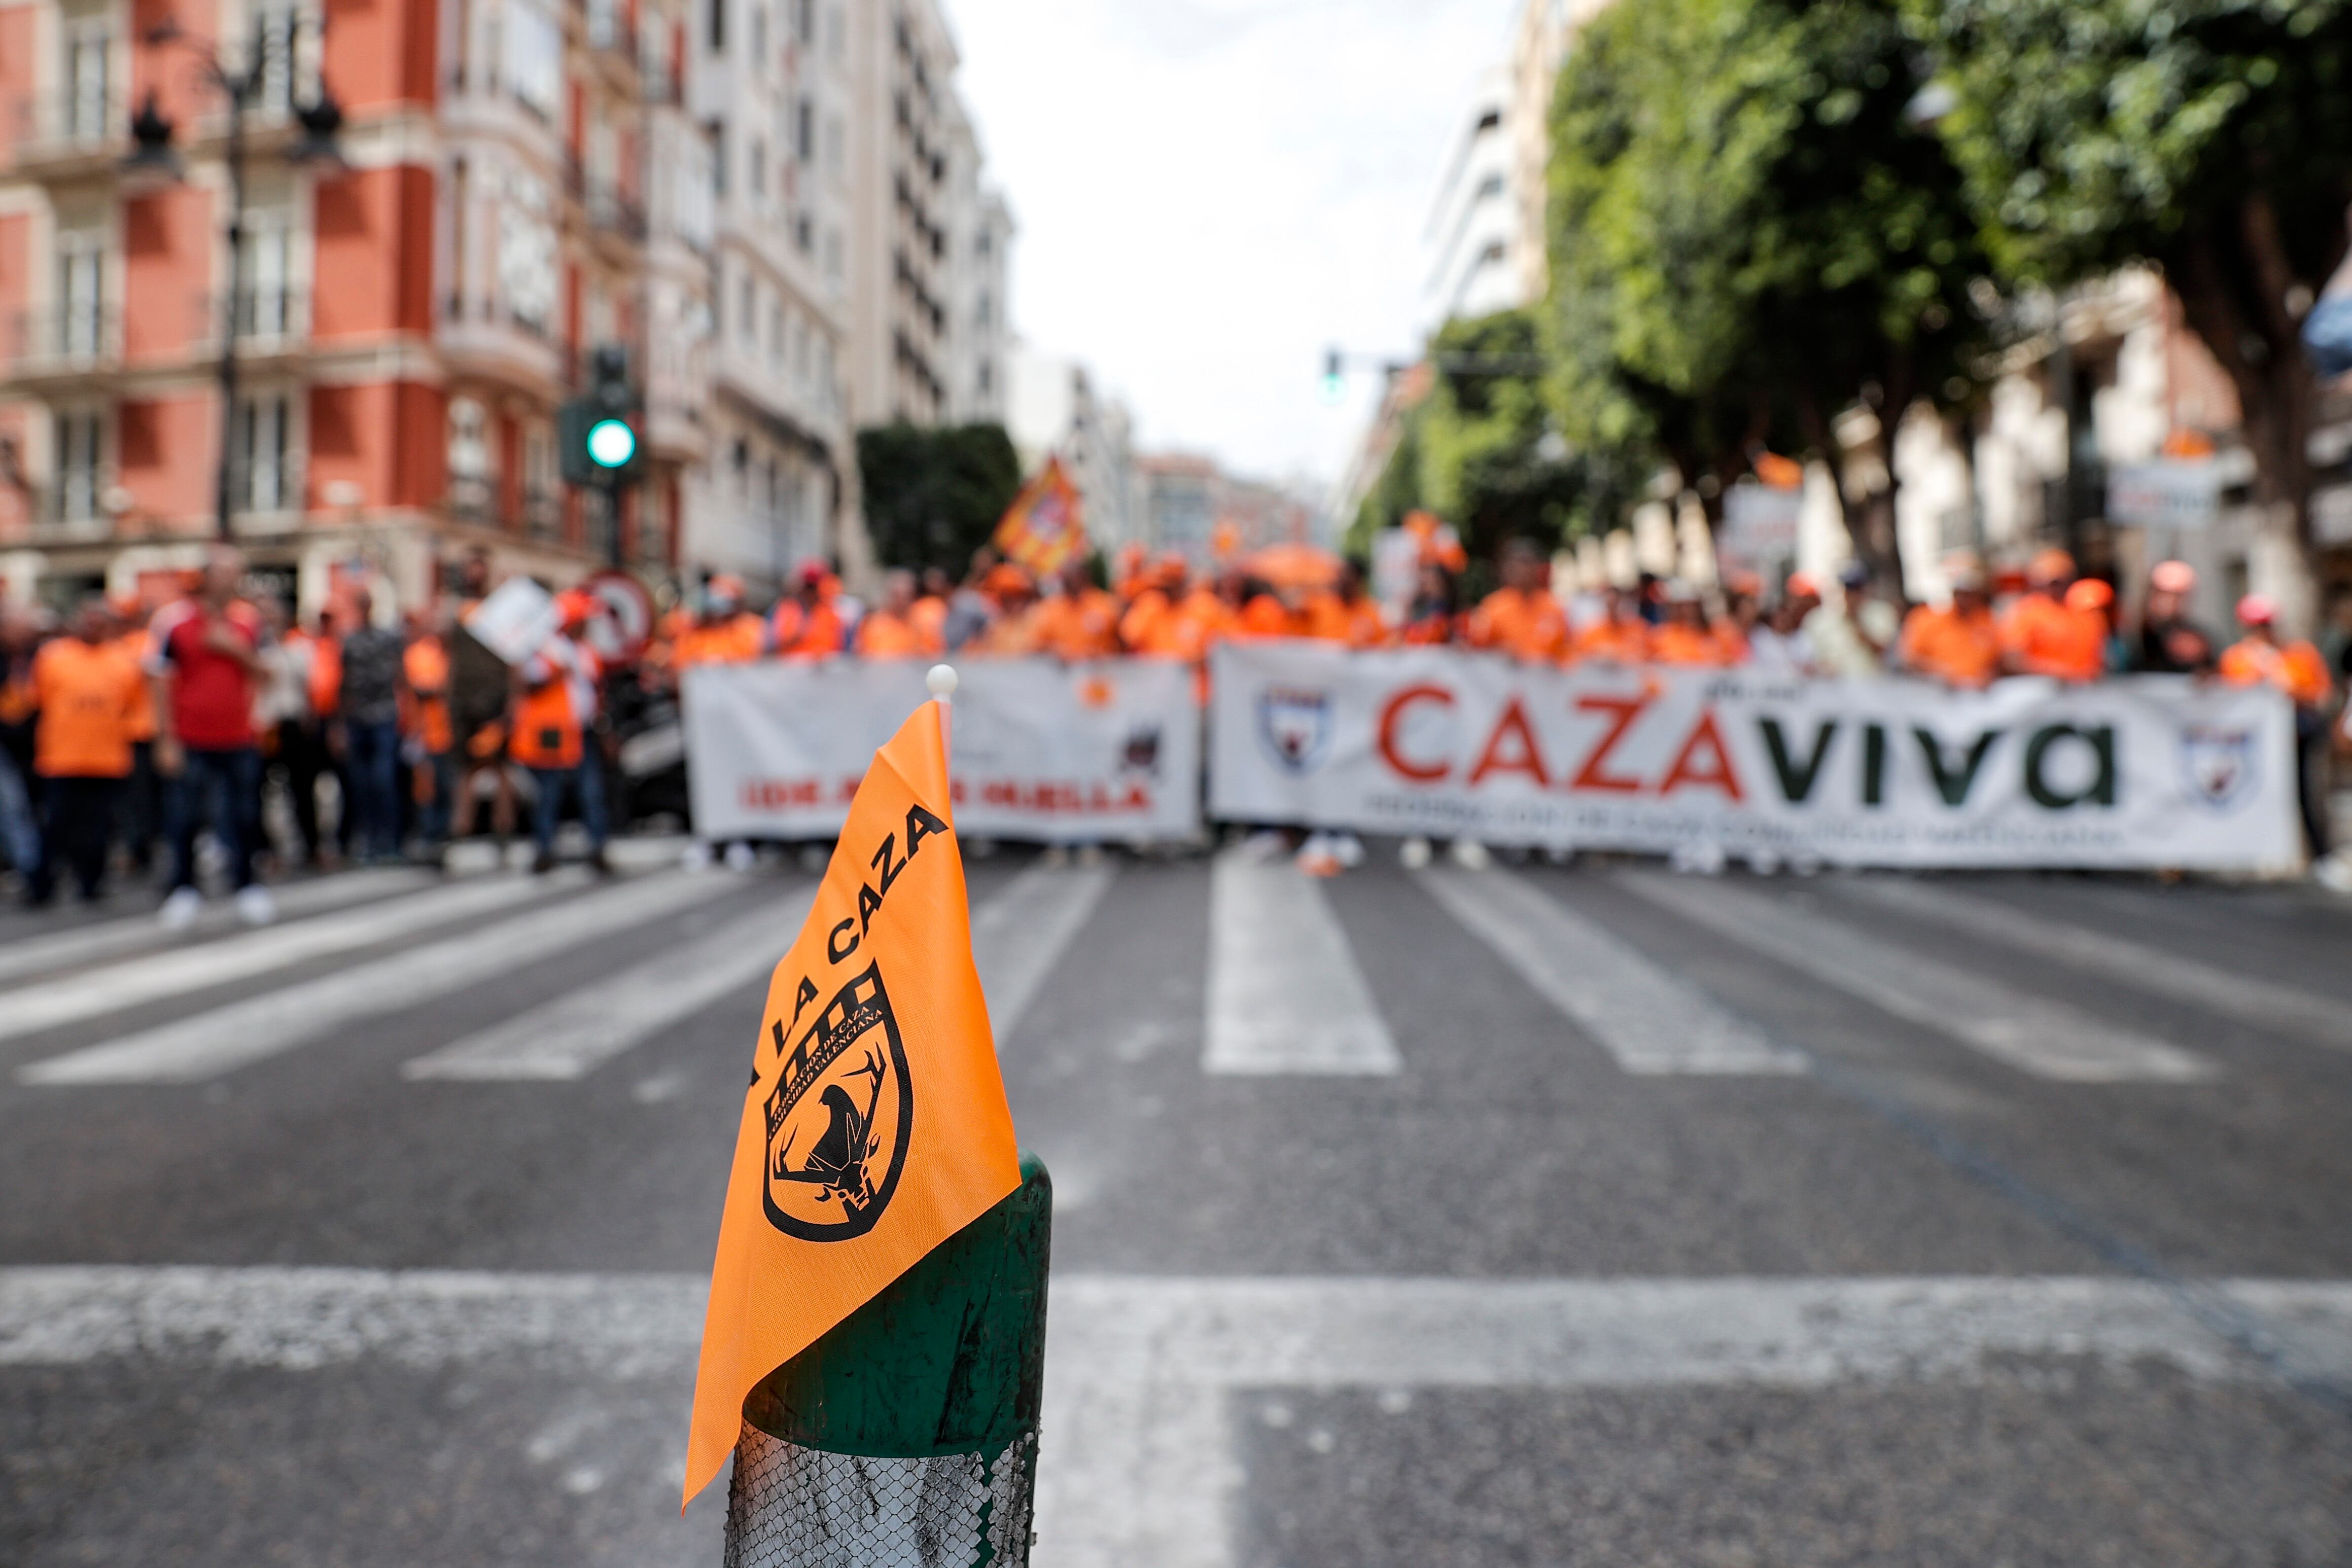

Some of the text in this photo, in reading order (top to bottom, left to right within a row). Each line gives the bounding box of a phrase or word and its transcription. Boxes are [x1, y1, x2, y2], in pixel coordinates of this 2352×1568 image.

[772, 803, 949, 1058] LA CAZA
[815, 1009, 883, 1071] VALENCIANA
[824, 1032, 836, 1050] DE
[838, 1006, 869, 1034] CAZA
